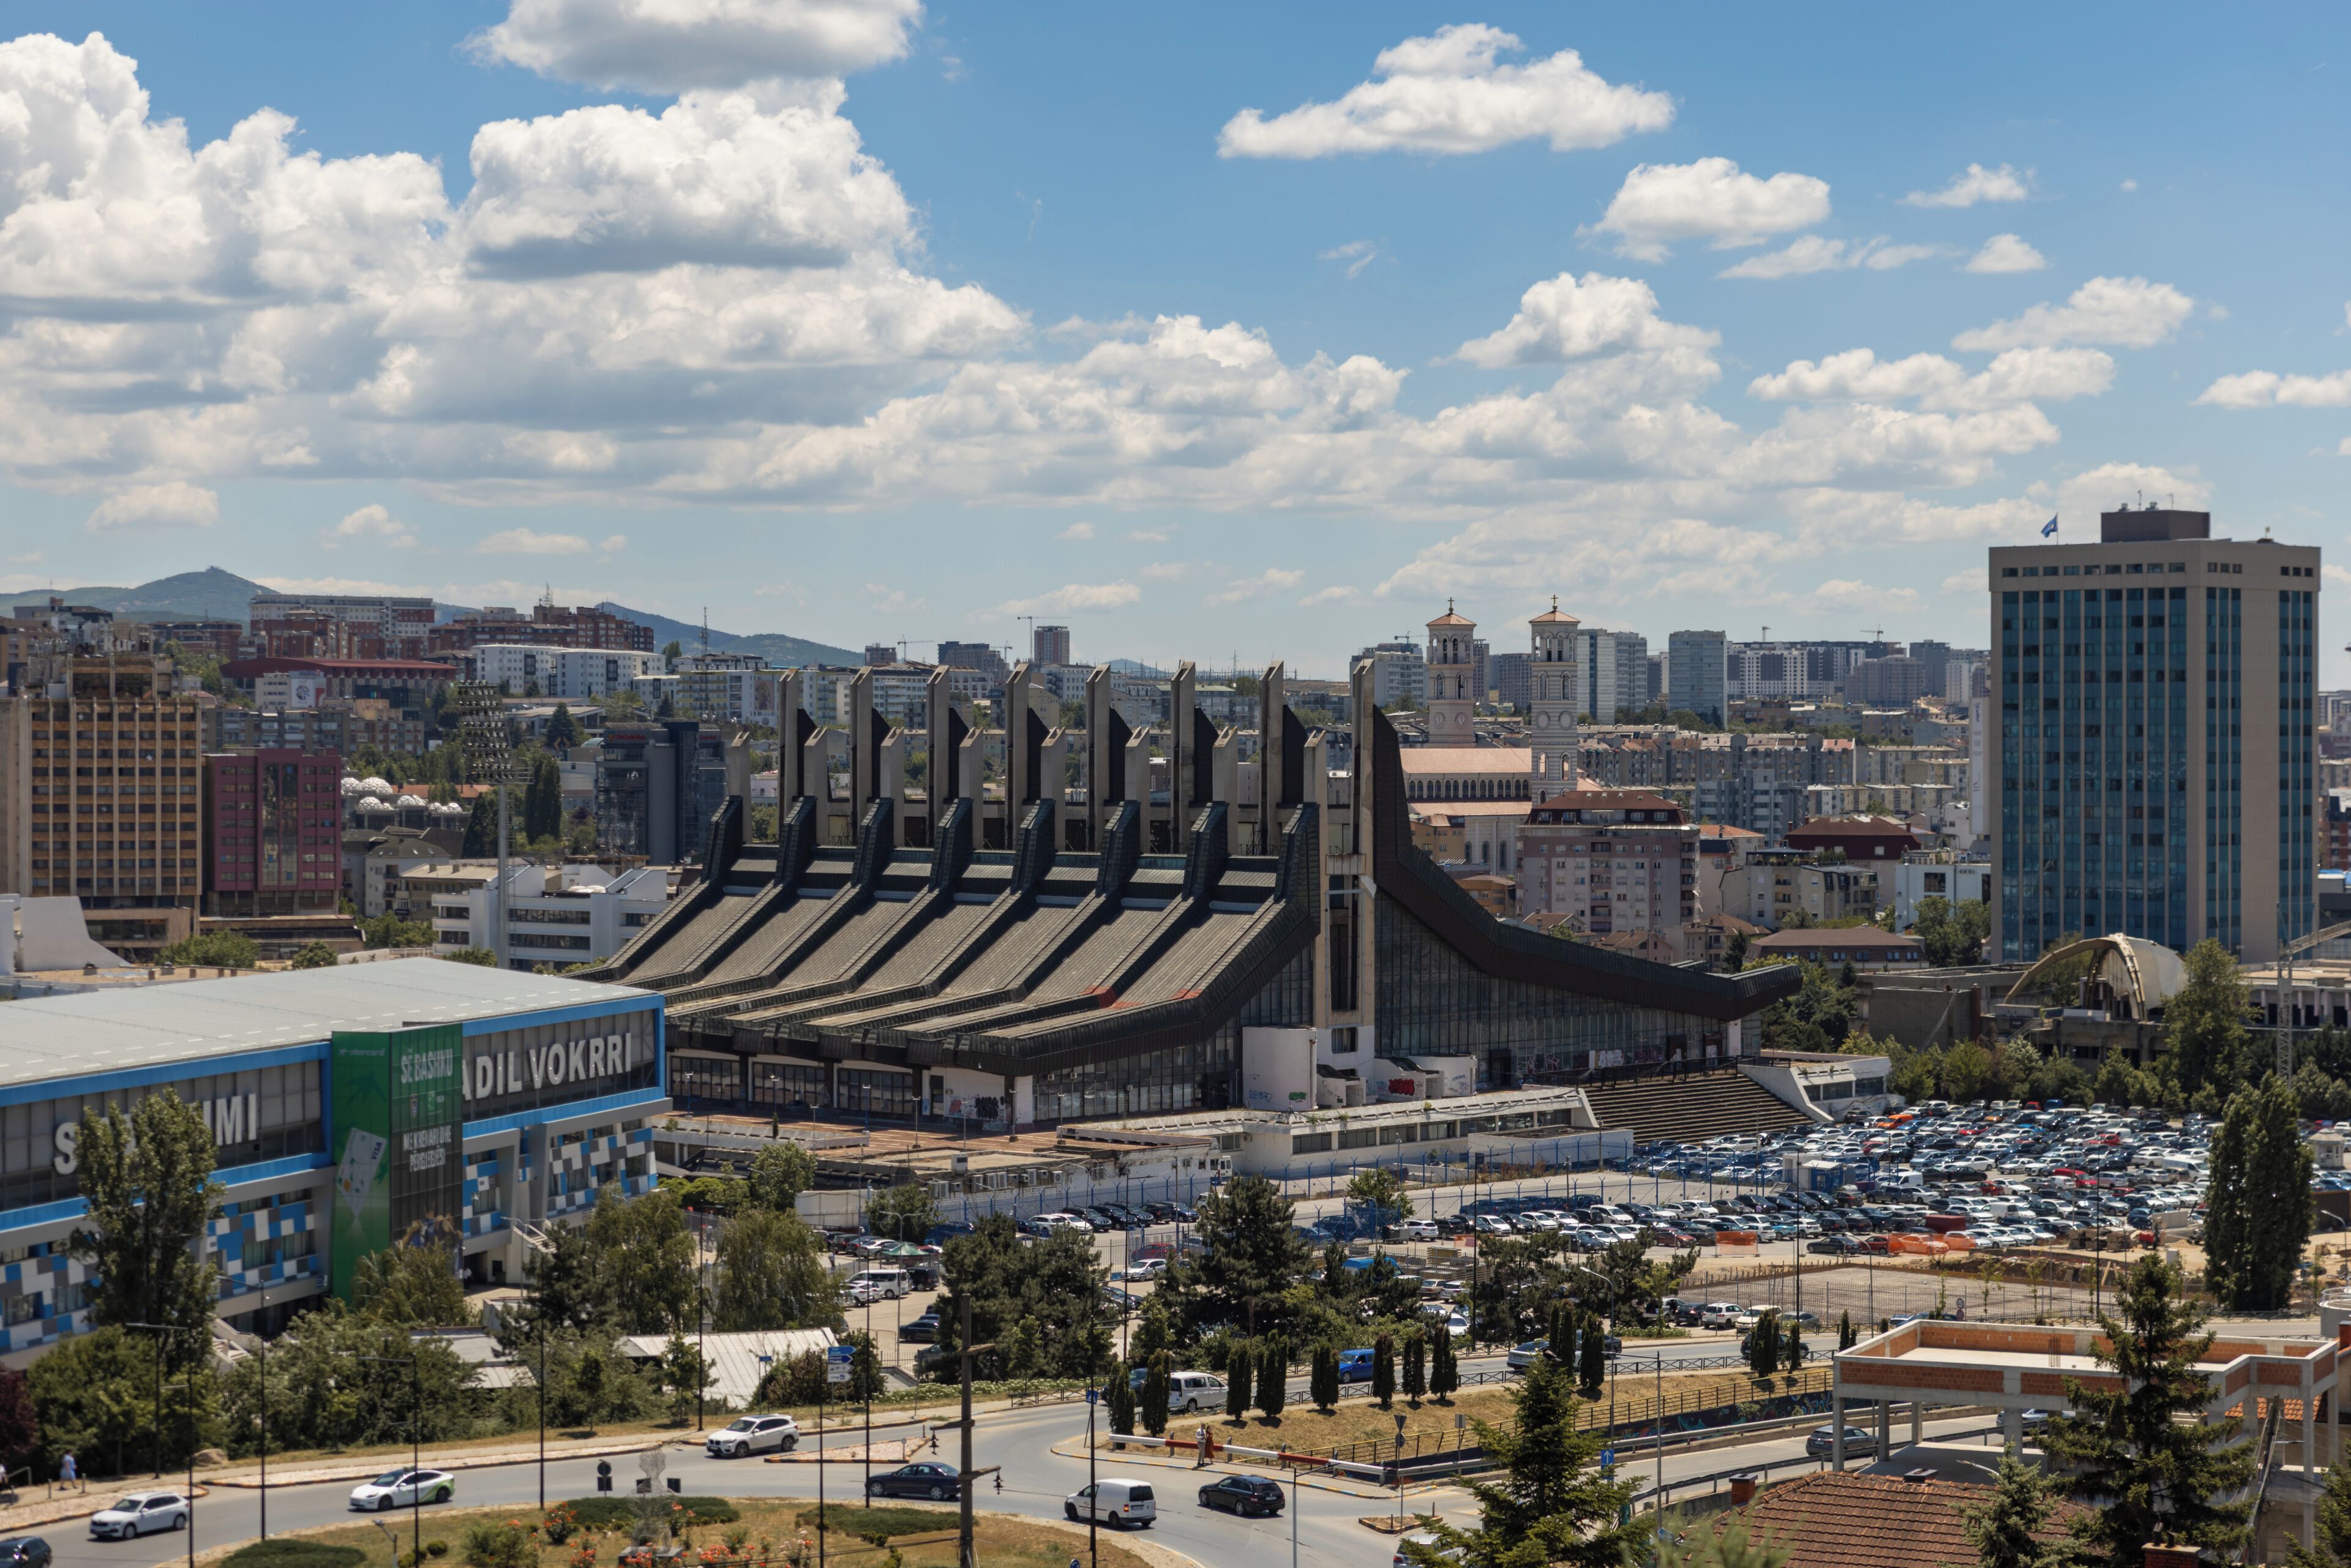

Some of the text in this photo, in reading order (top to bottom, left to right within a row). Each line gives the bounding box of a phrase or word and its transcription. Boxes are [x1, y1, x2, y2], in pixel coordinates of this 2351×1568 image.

[350, 1048, 385, 1056] starcard
[530, 1033, 631, 1089] VOKRRI
[401, 1048, 453, 1083] SË BASHKU
[440, 1125, 452, 1143] DHE
[370, 1142, 384, 1160] VISA
